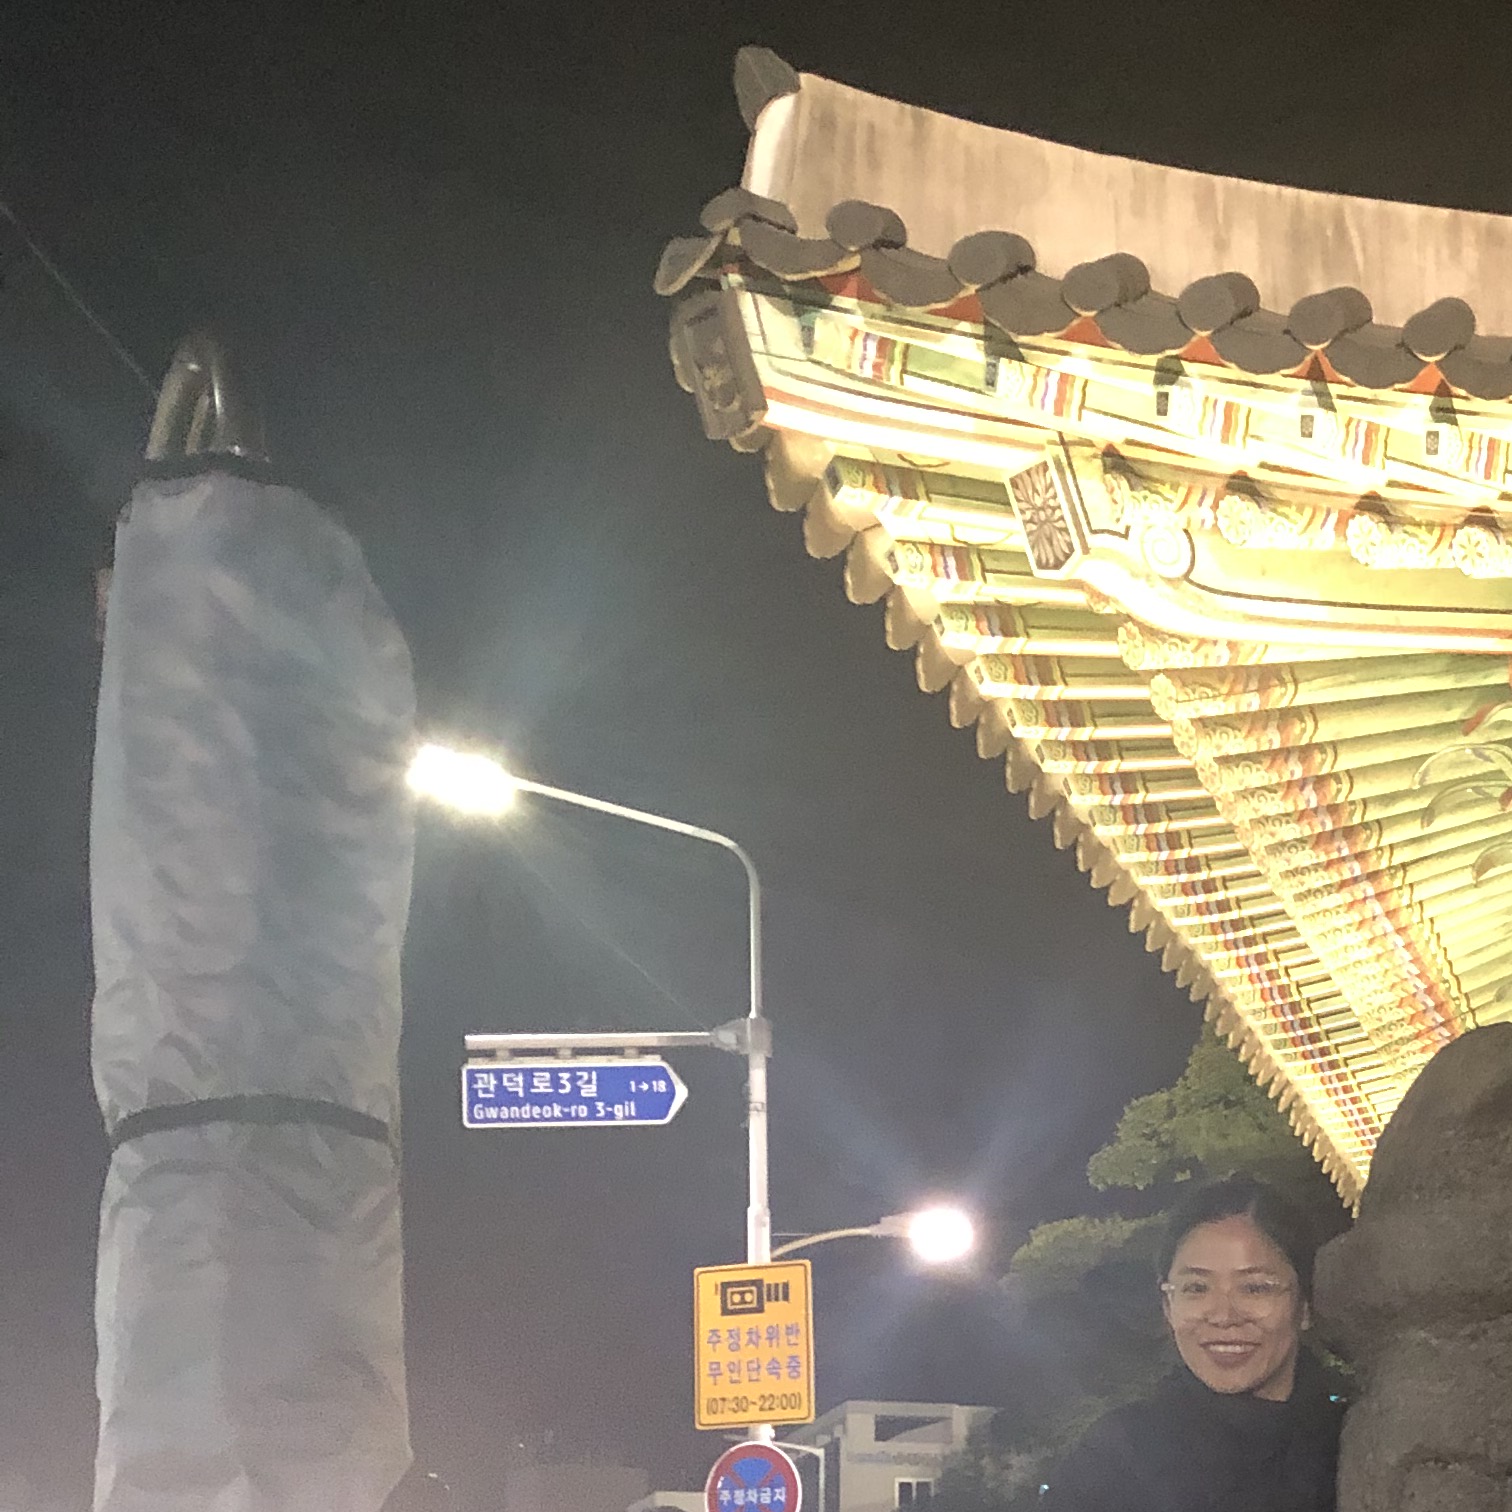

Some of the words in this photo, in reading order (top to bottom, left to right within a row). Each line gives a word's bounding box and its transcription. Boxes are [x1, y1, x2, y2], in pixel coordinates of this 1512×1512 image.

[472, 1071, 598, 1098] 관덕로3길
[473, 1103, 588, 1120] Gwandeok-ro
[594, 1101, 636, 1121] 3-gil
[707, 1323, 800, 1352] 주정차위반
[707, 1355, 801, 1386] 무인단속중
[719, 1486, 786, 1506] 주정차금지
